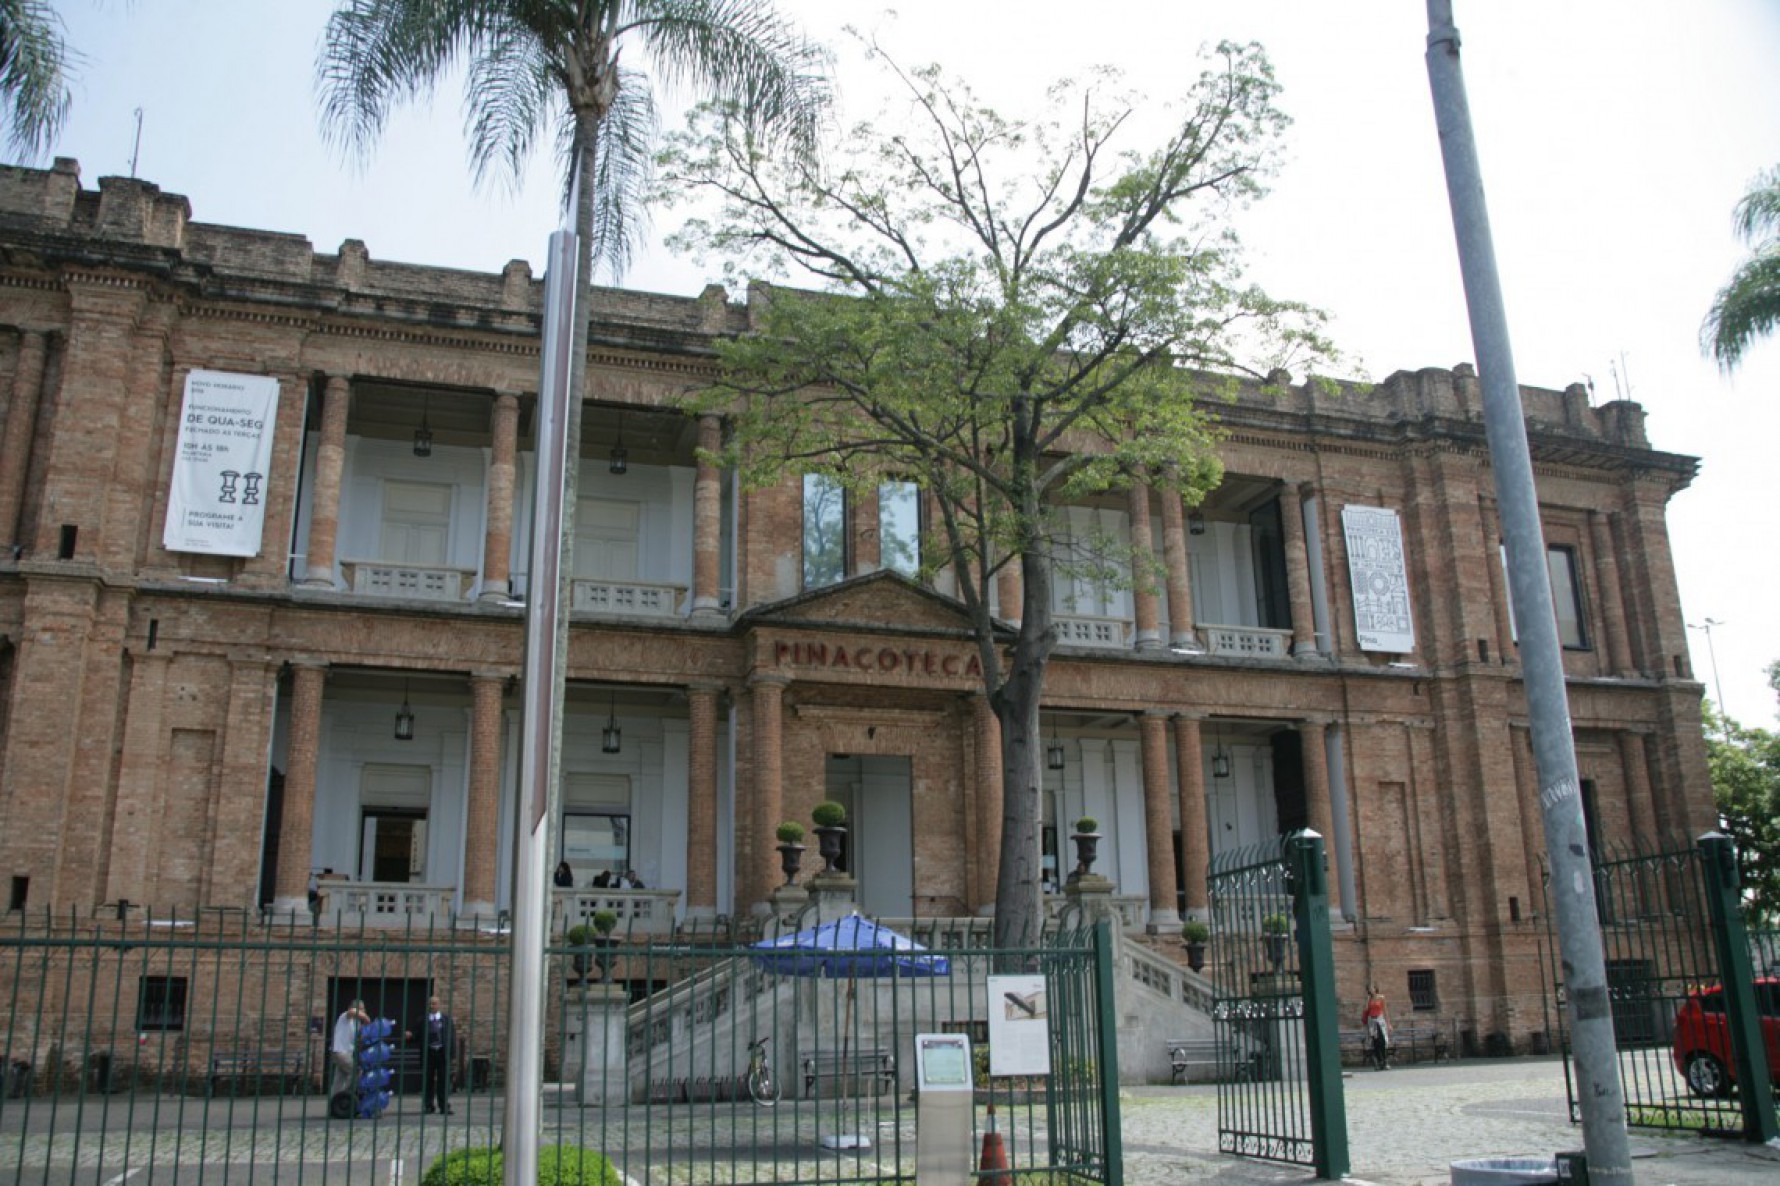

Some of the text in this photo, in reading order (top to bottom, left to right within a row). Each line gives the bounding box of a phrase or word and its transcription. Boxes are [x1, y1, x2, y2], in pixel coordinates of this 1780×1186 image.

[187, 413, 263, 430] DE QUA-SEG
[185, 426, 220, 435] FECHADO
[188, 511, 235, 521] PROGRAME
[774, 640, 982, 677] PINACOTECA
